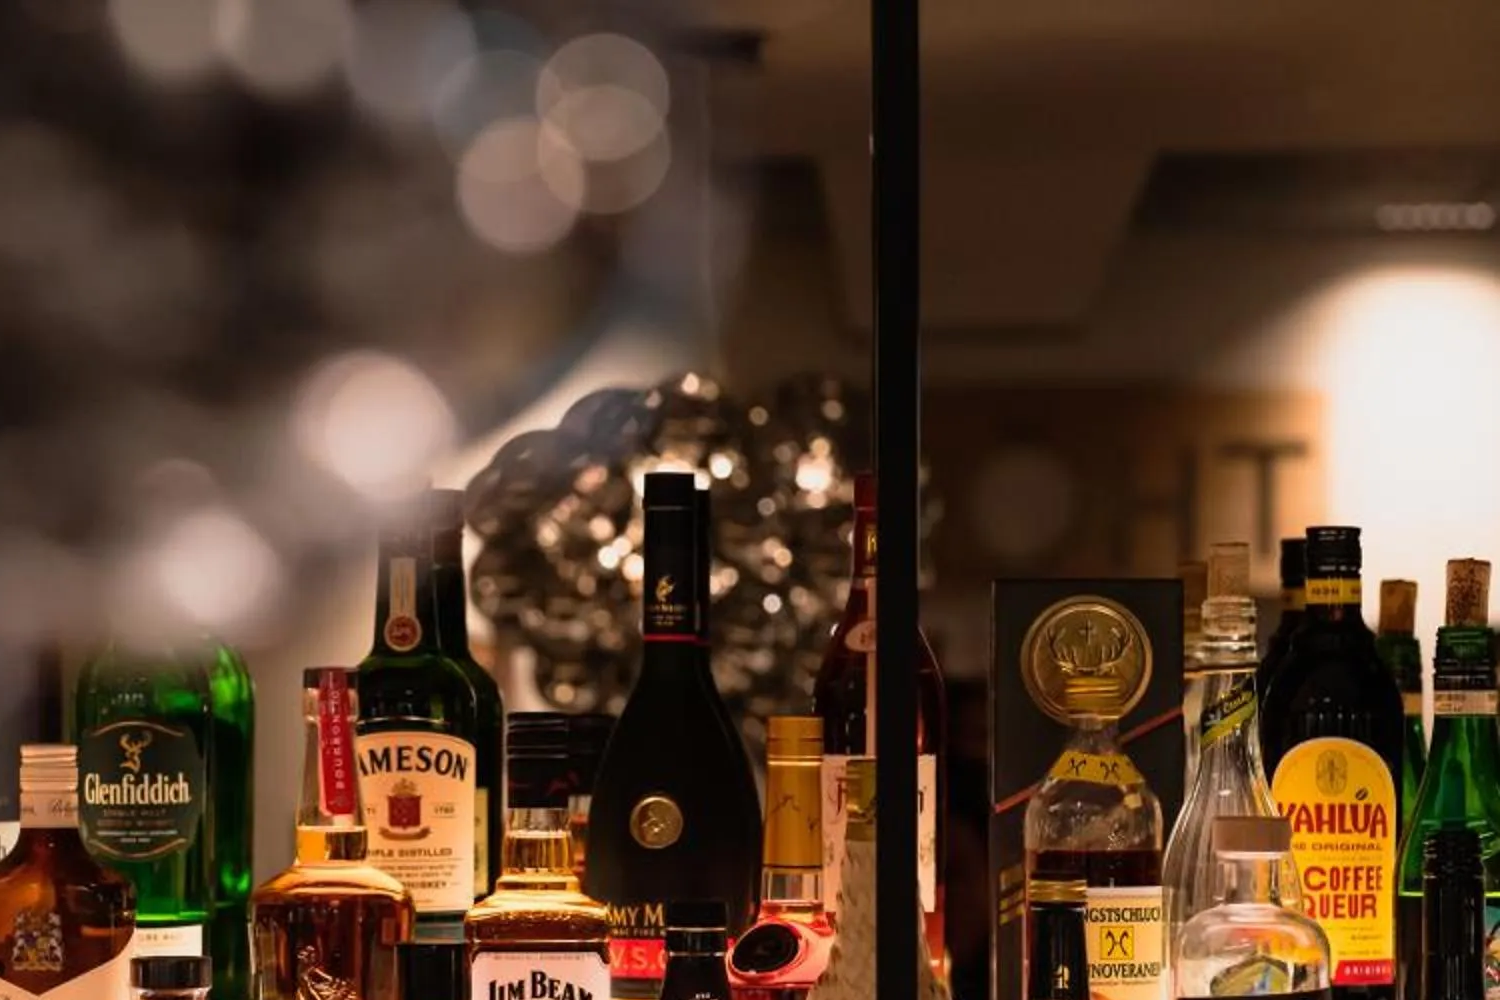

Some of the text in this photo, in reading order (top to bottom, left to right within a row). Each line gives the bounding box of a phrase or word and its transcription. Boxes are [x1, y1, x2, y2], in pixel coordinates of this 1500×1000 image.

[84, 772, 192, 805] Glenfiddich
[1303, 865, 1383, 893] COFFEE
[1303, 894, 1378, 920] QUEUR
